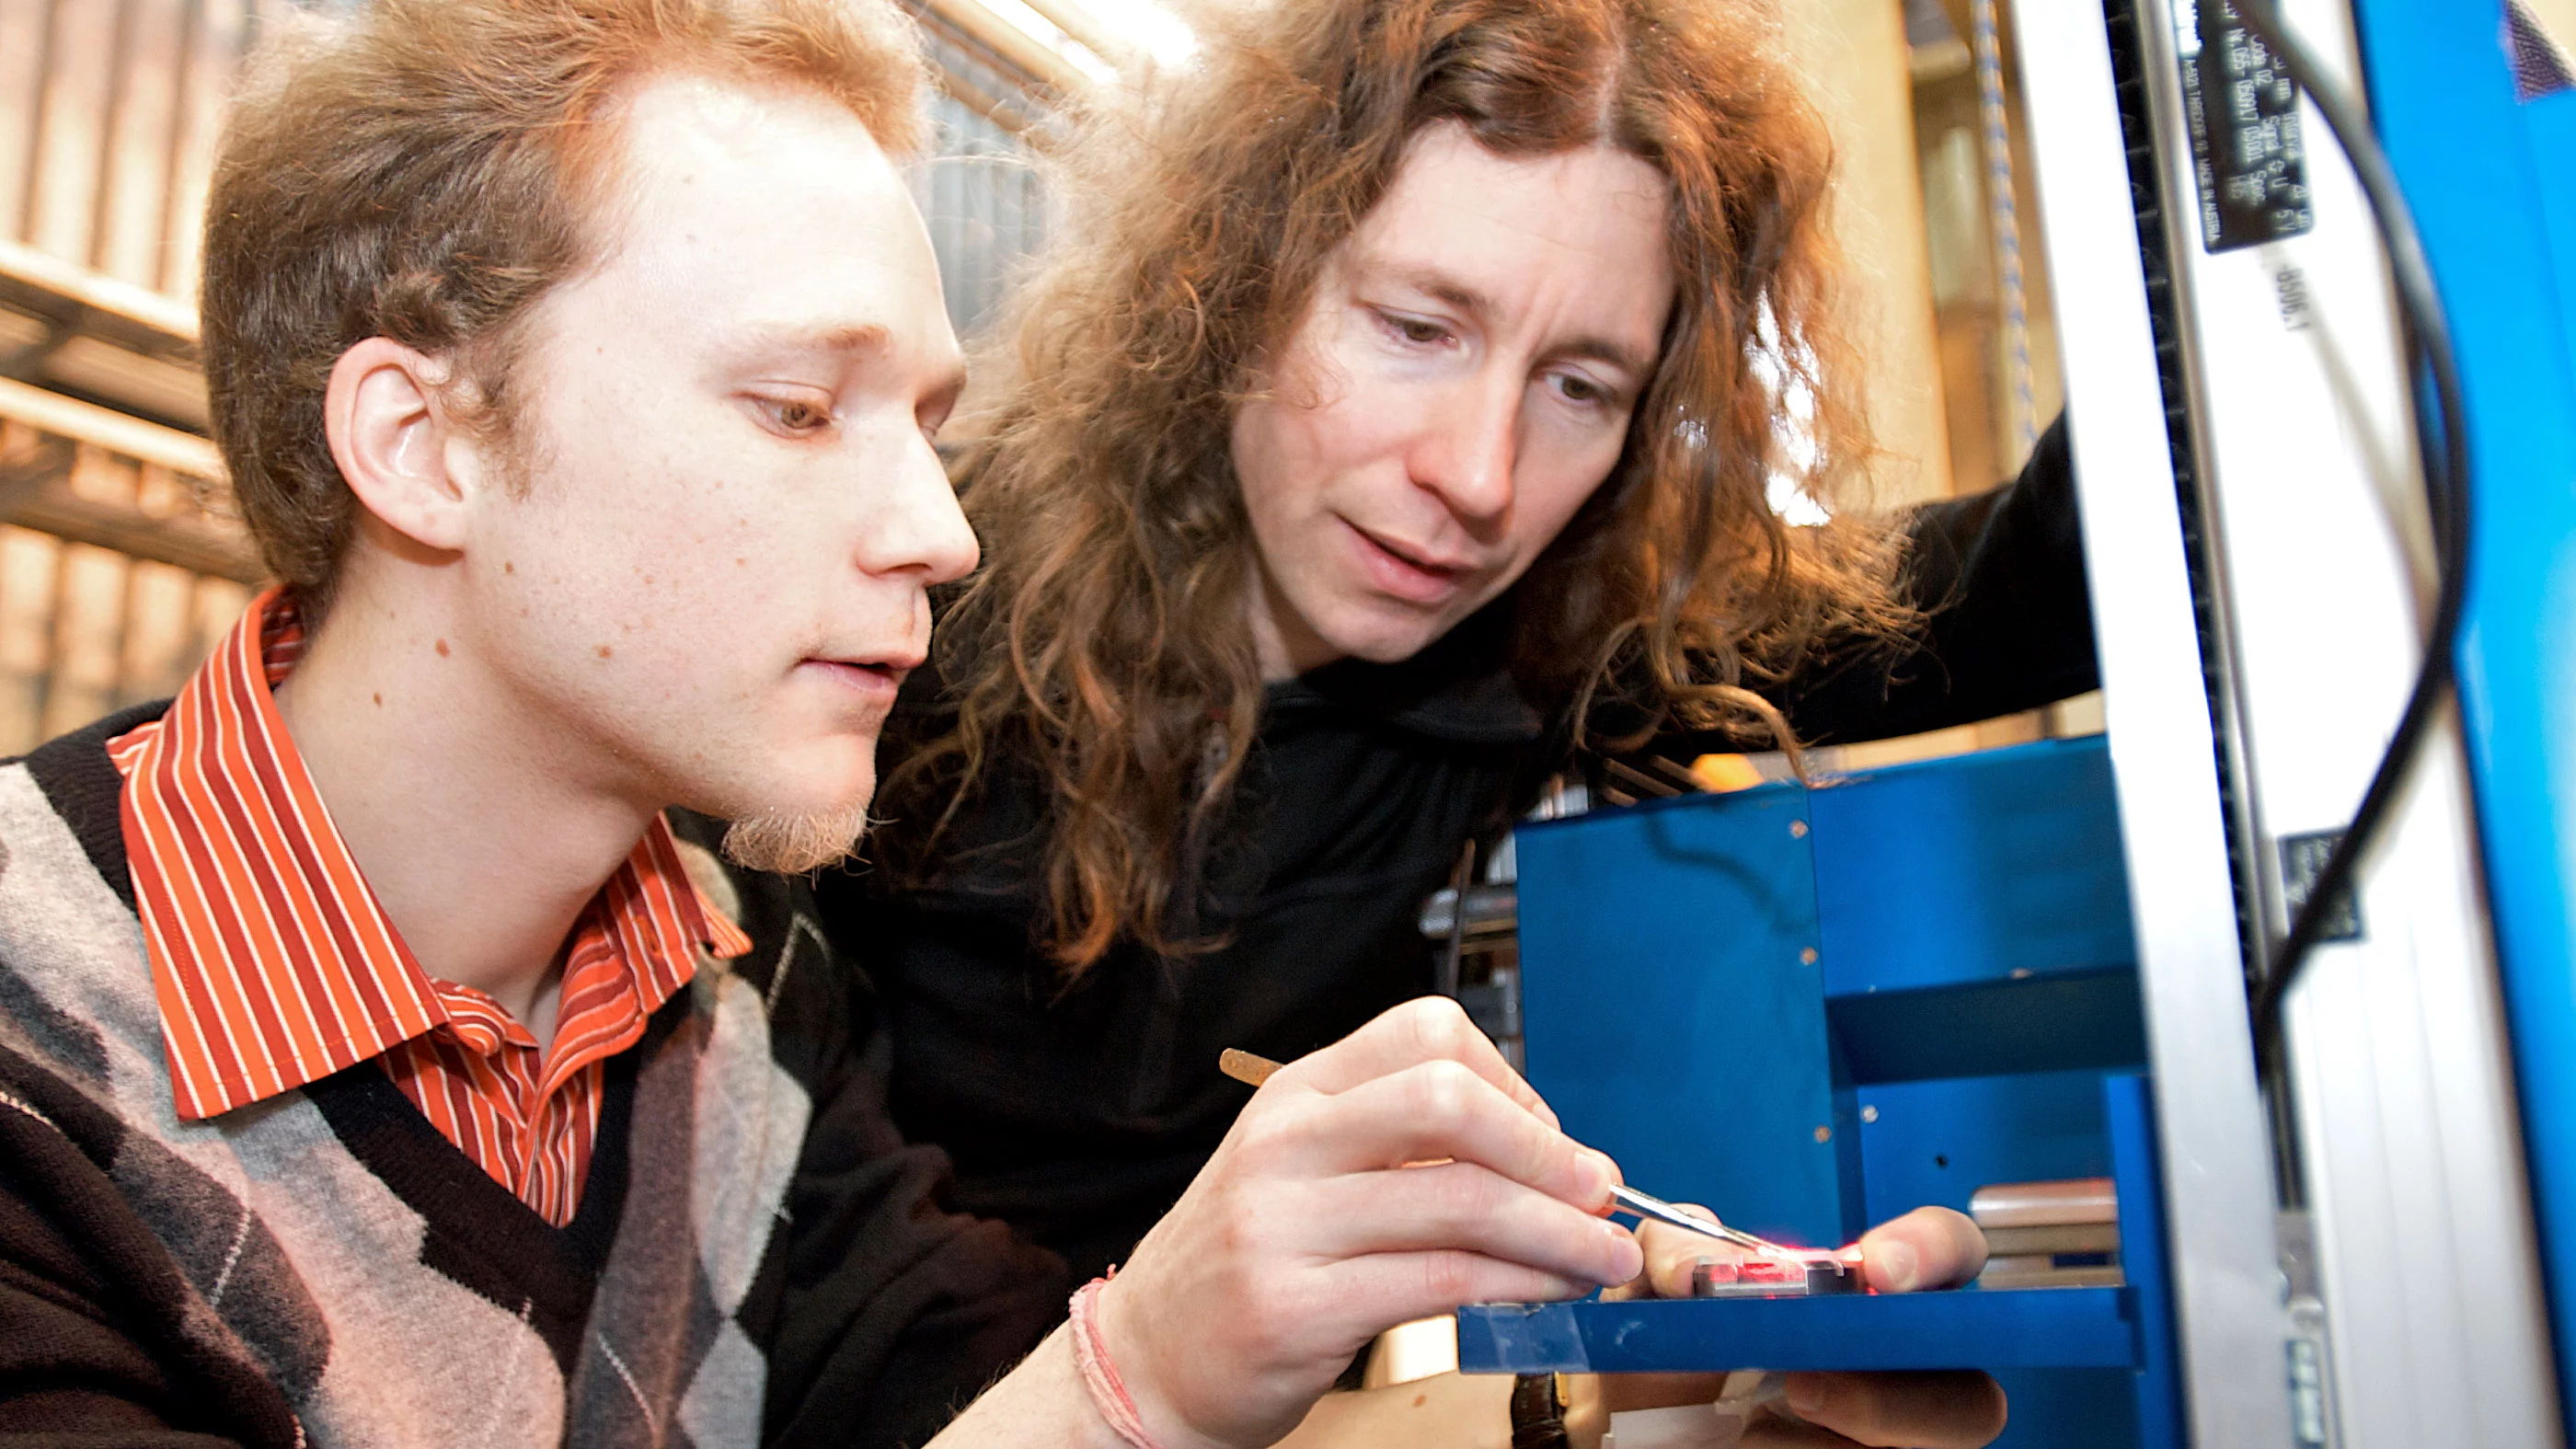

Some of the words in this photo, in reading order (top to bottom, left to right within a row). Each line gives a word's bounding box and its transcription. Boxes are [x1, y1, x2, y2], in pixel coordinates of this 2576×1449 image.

[2255, 69, 2274, 86] 02
[2260, 115, 2283, 153] Signal
[2197, 158, 2214, 187] MADE
[2202, 189, 2216, 201] IN
[2203, 202, 2223, 246] AUSTRIA
